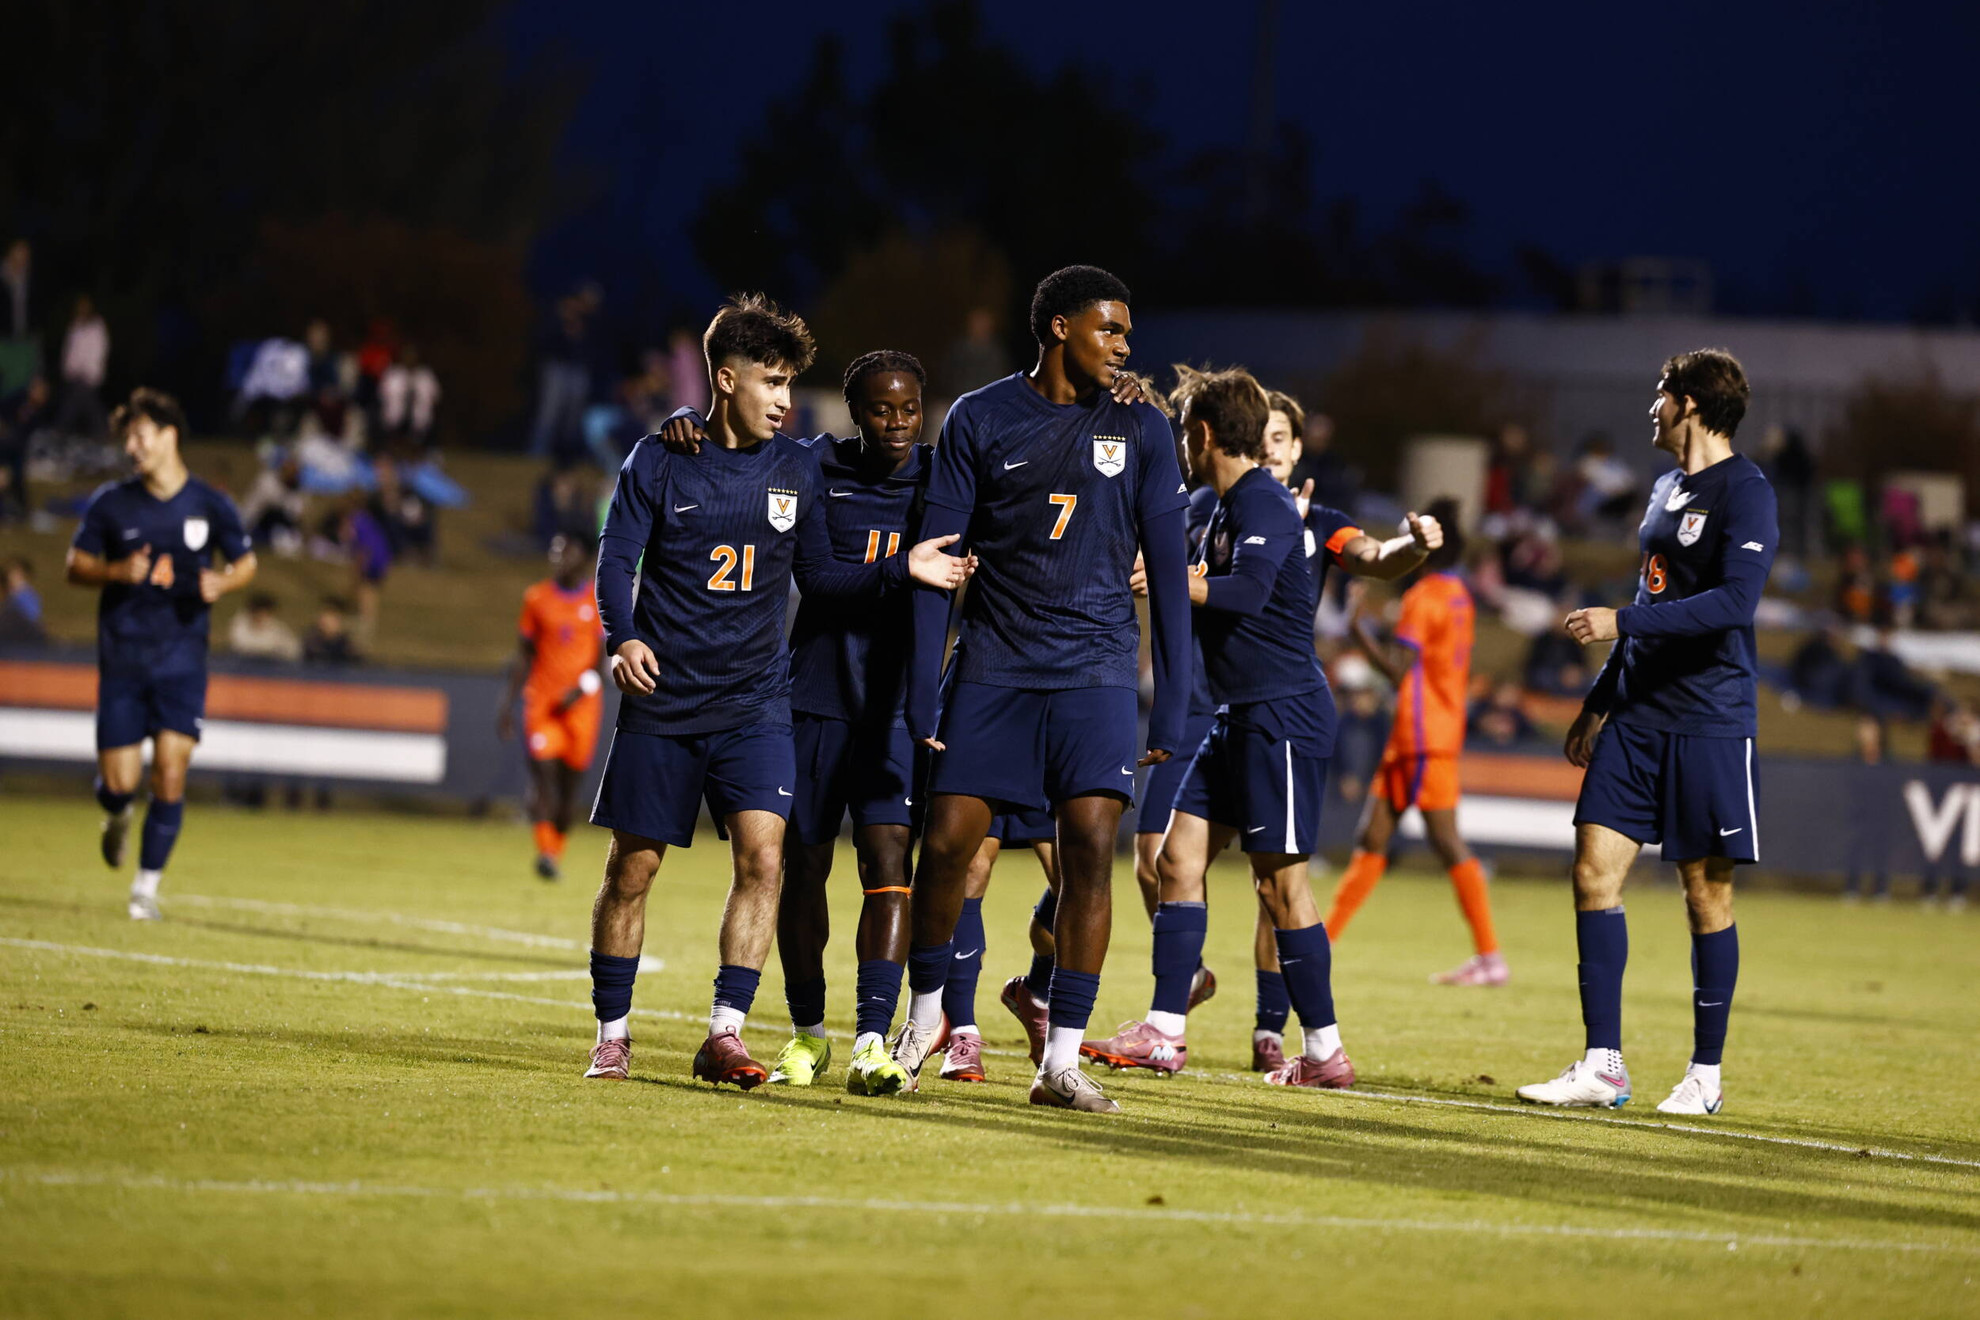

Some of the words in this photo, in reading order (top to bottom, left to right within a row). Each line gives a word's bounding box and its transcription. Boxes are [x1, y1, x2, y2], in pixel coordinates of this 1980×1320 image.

[1049, 493, 1077, 540] 7
[707, 544, 756, 592] 21
[1903, 779, 1980, 867] VI
